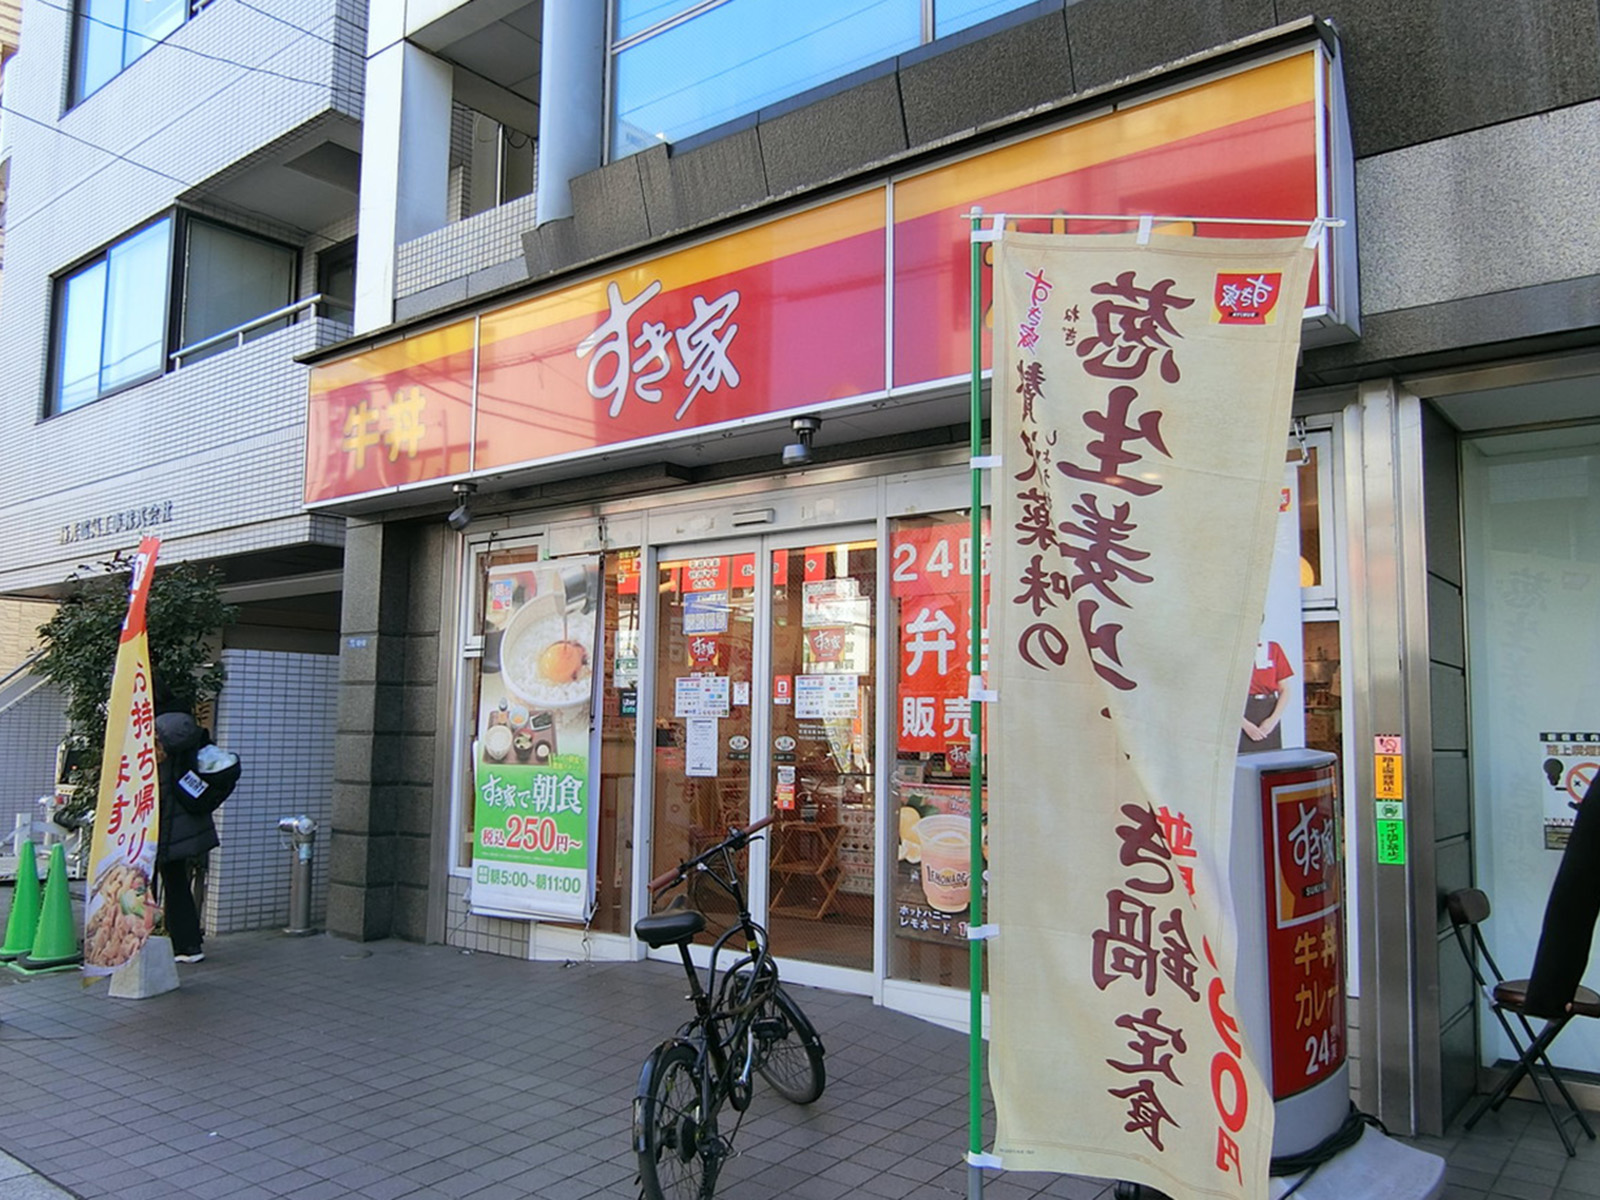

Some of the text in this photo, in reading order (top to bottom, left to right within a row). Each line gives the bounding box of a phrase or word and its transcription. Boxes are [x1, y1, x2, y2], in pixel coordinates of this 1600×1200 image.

[575, 279, 741, 420] すき家
[342, 385, 427, 471] 牛丼
[481, 773, 584, 815] すき家で朝食
[1294, 925, 1337, 976] 牛丼
